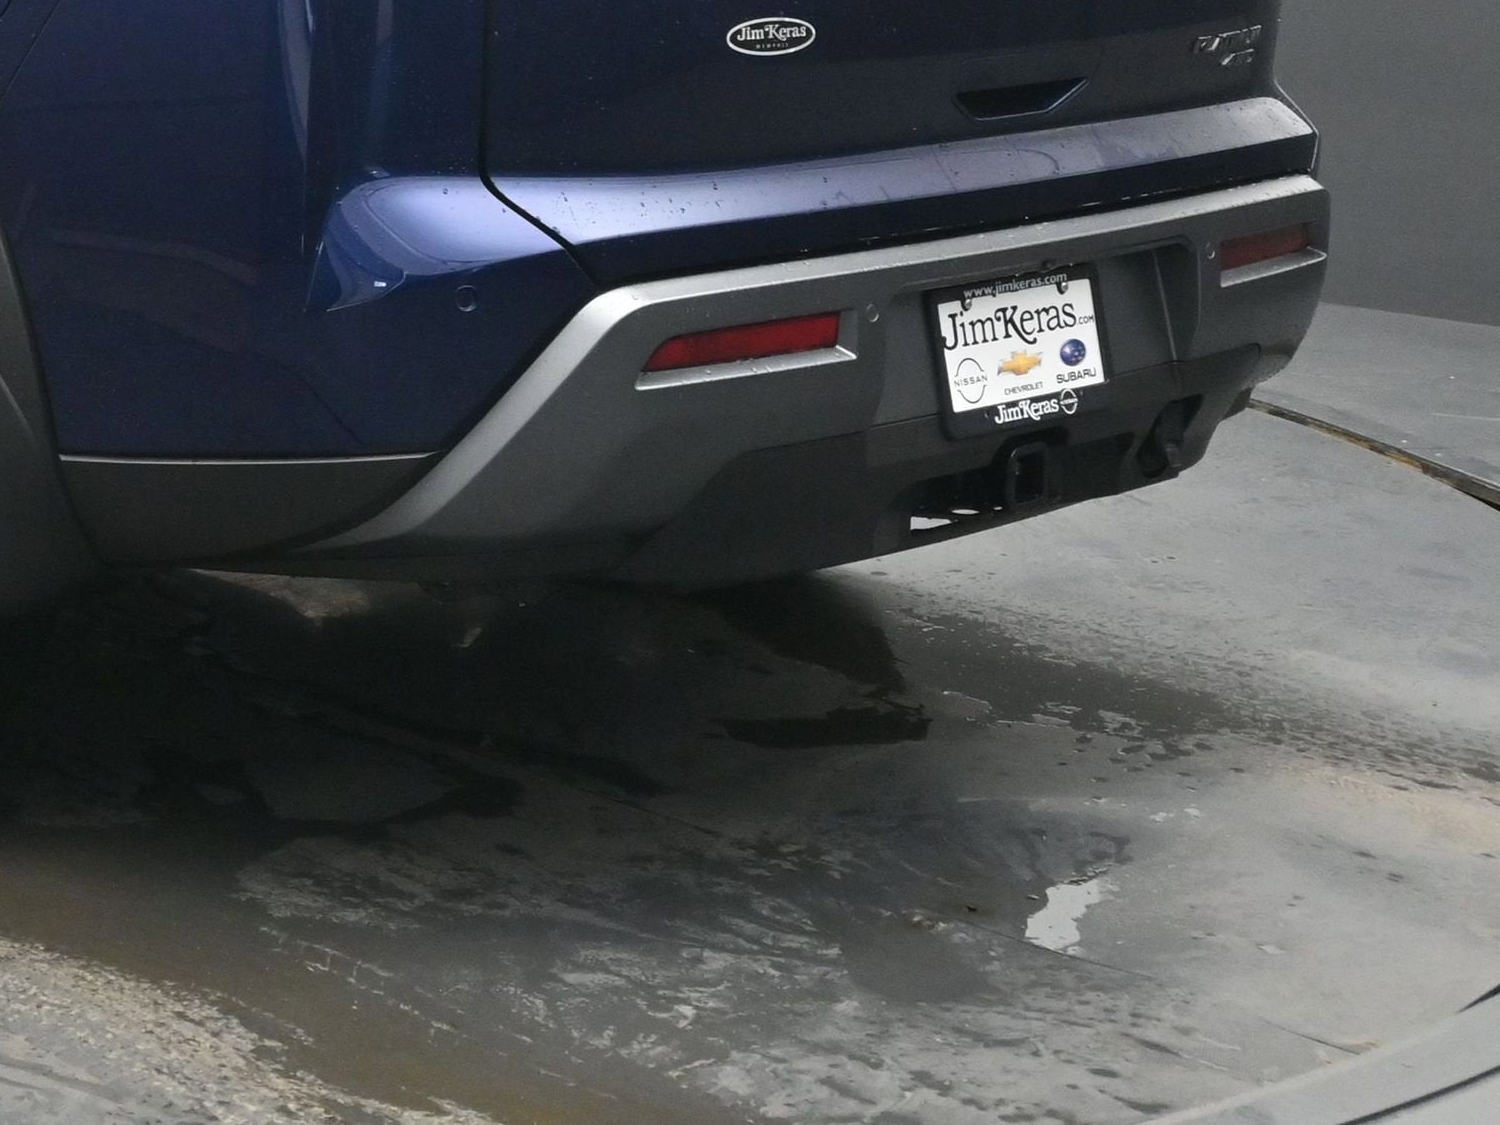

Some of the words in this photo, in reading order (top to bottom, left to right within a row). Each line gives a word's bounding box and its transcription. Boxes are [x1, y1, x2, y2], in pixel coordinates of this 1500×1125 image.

[964, 273, 1068, 299] www.jimkeras.com
[954, 375, 988, 388] NISSAN
[1056, 368, 1097, 384] SUBARU
[1004, 381, 1044, 396] CHEVROLET
